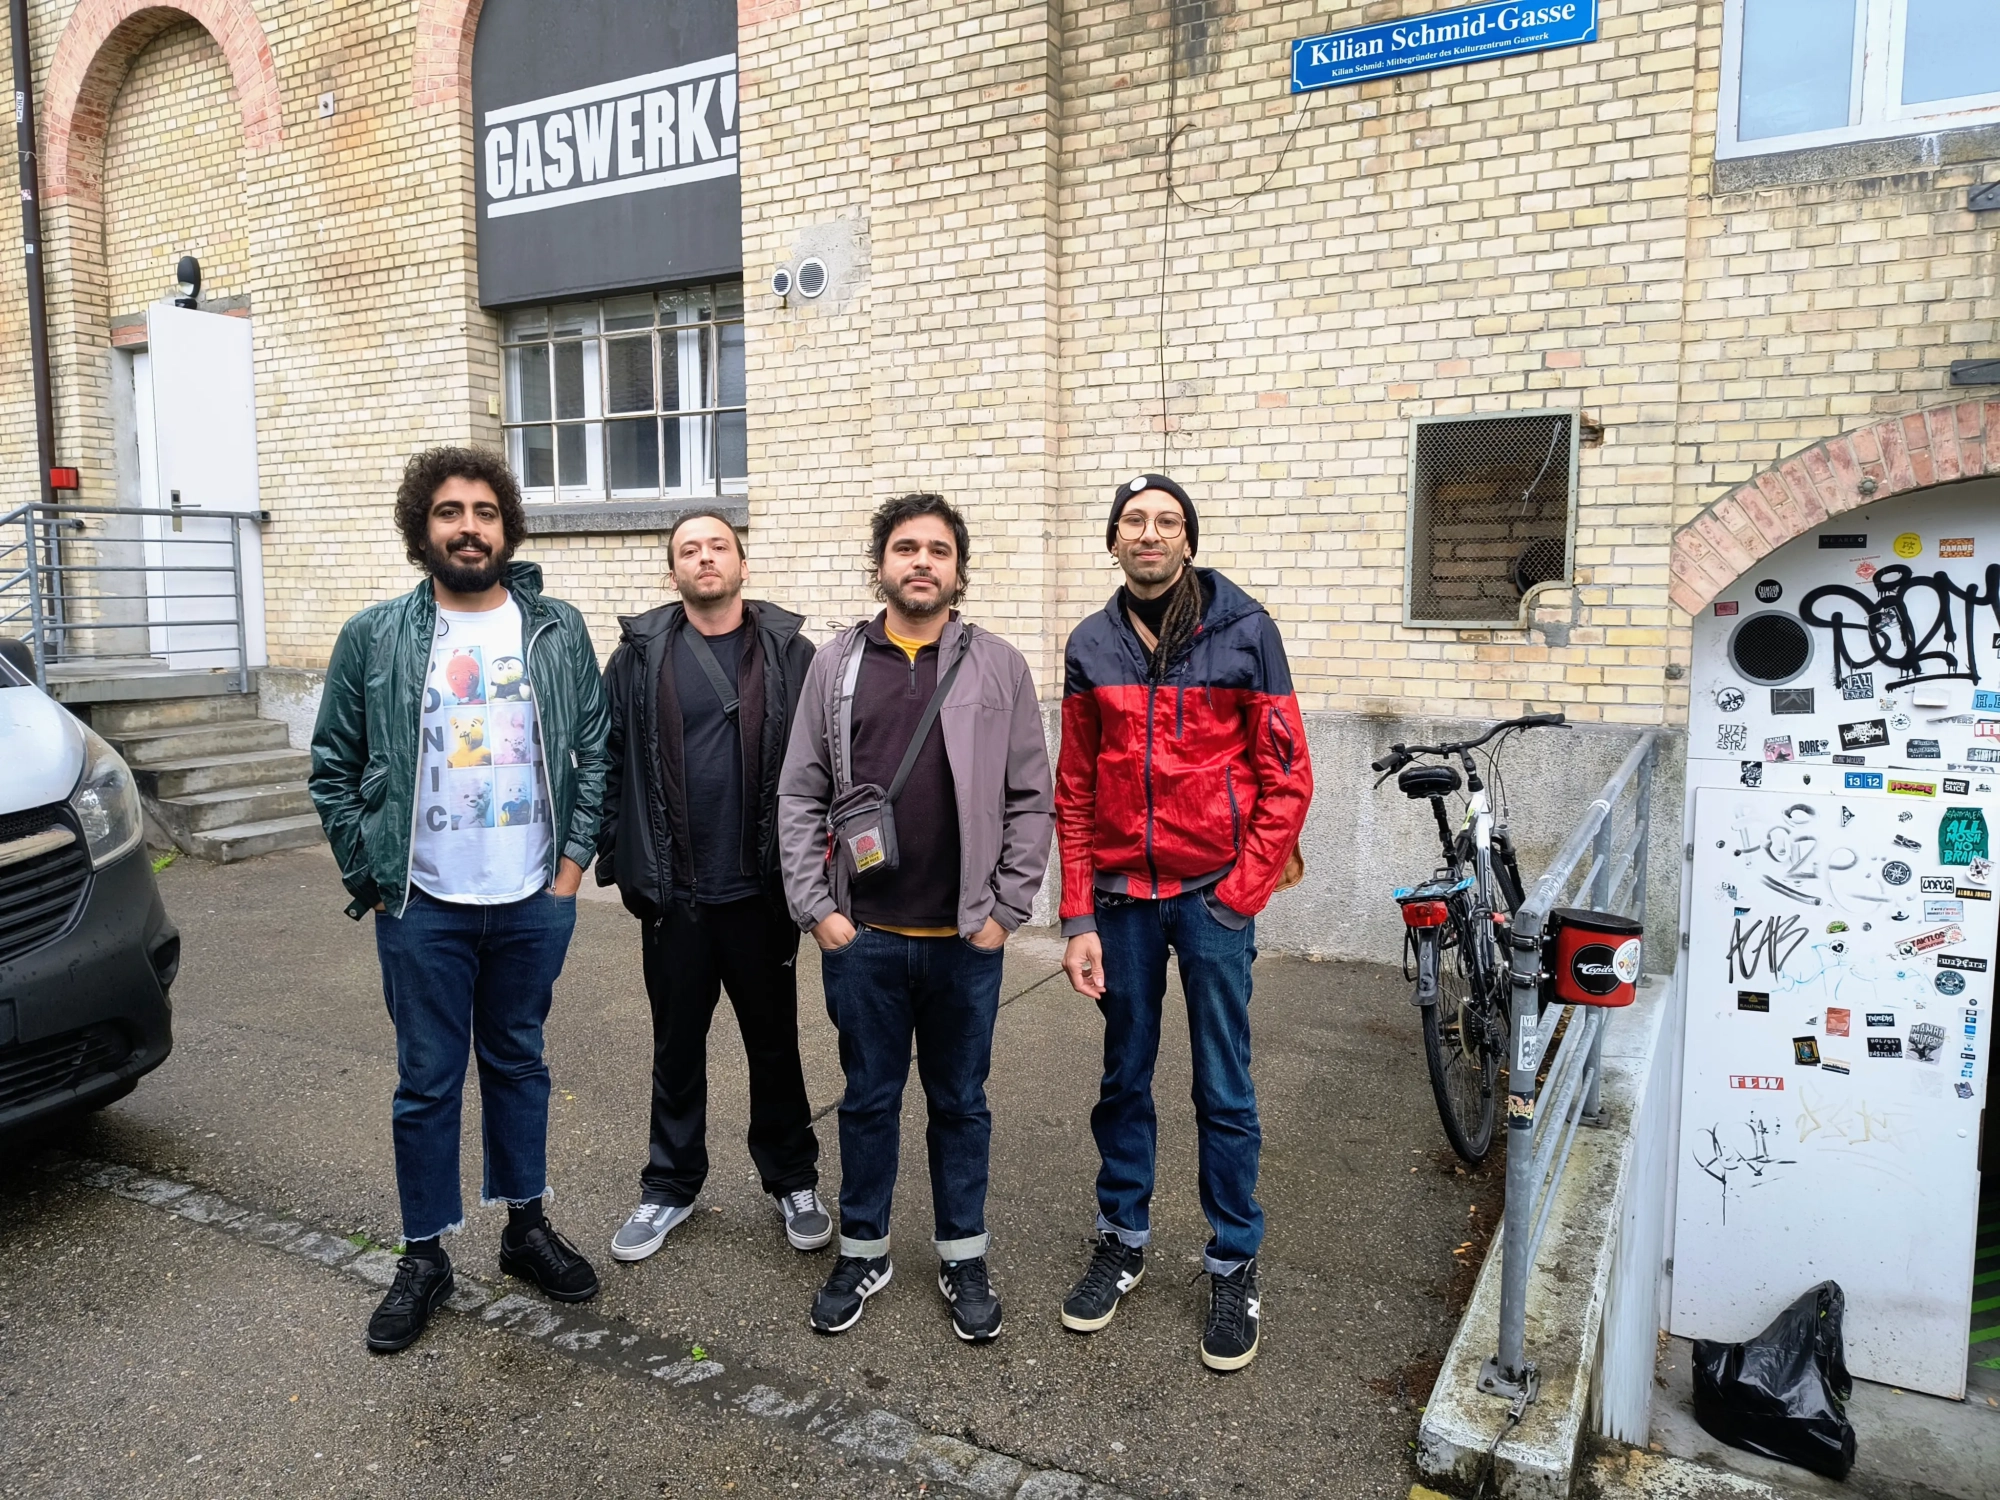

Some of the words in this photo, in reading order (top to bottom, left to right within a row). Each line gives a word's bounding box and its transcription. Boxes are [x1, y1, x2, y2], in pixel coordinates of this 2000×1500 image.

[1310, 36, 1383, 67] Kilian
[1391, 3, 1576, 51] Schmid-Gasse
[1331, 65, 1353, 77] Kilian
[1354, 59, 1385, 74] Schmid:
[1386, 51, 1438, 68] Mitbegründer
[1439, 48, 1452, 58] des
[1453, 38, 1512, 56] Kulturzentrum
[1513, 31, 1549, 45] Gaswerk
[485, 73, 737, 199] GASWERK!
[1799, 740, 1820, 753] BORE
[1848, 777, 1860, 786] 13
[1867, 777, 1880, 787] 12
[1944, 785, 1965, 793] SLICE
[1947, 820, 1983, 833] ALL
[1946, 832, 1981, 843] MOSH
[1954, 841, 1973, 851] NO
